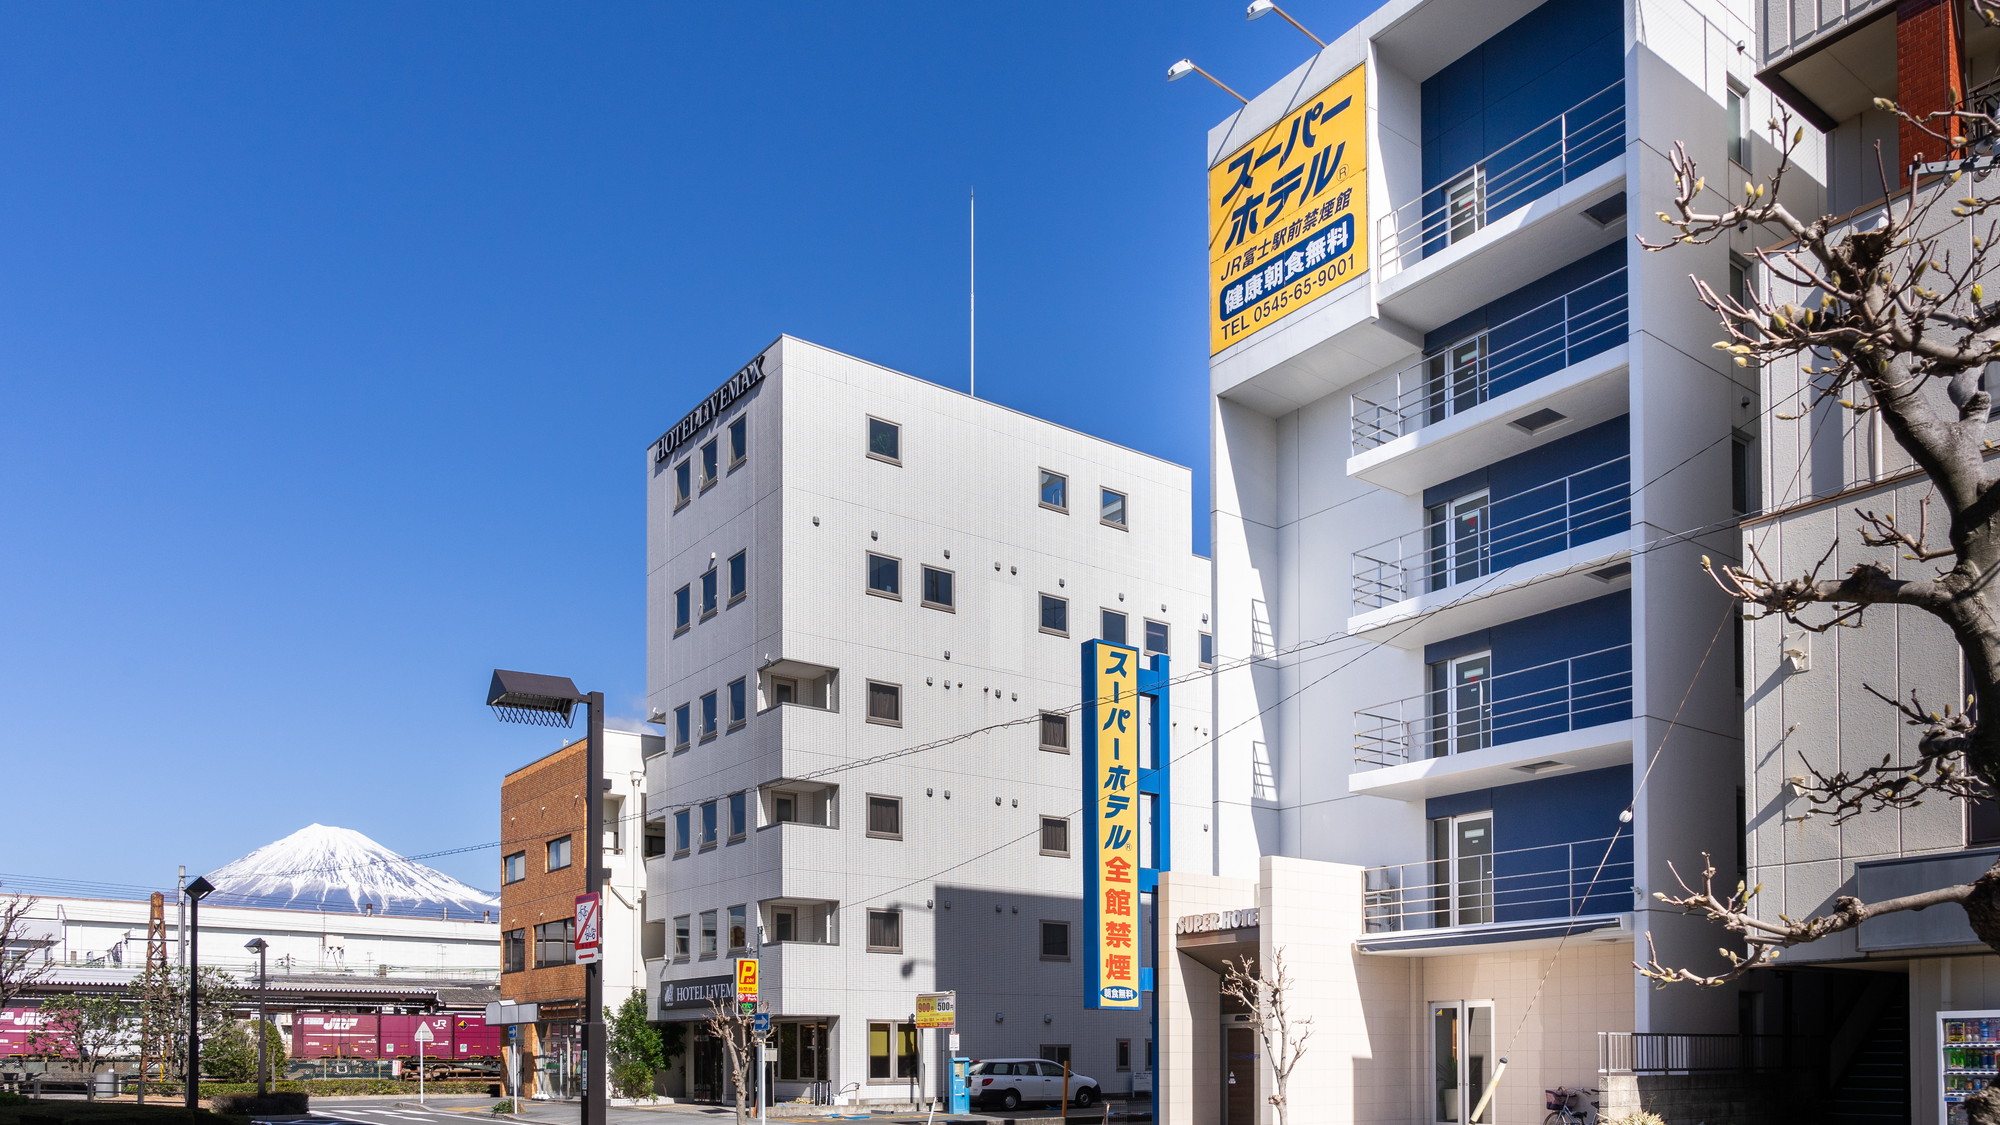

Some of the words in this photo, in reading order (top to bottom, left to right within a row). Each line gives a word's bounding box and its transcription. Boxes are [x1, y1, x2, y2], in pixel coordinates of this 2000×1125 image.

[1221, 95, 1352, 208] スーパー
[1223, 141, 1346, 253] ホテル
[1221, 187, 1351, 282] JR富士駅前禁煙館
[1224, 220, 1350, 314] 健康朝食無料
[1221, 317, 1250, 341] TEL
[1254, 253, 1355, 322] 0545-65-9001
[656, 413, 697, 462] HOTEL
[1105, 856, 1132, 981] 全館禁煙
[1177, 912, 1220, 934] SUPER
[676, 986, 705, 1002] HOTEL
[706, 983, 734, 999] LiVEM
[740, 961, 756, 983] P
